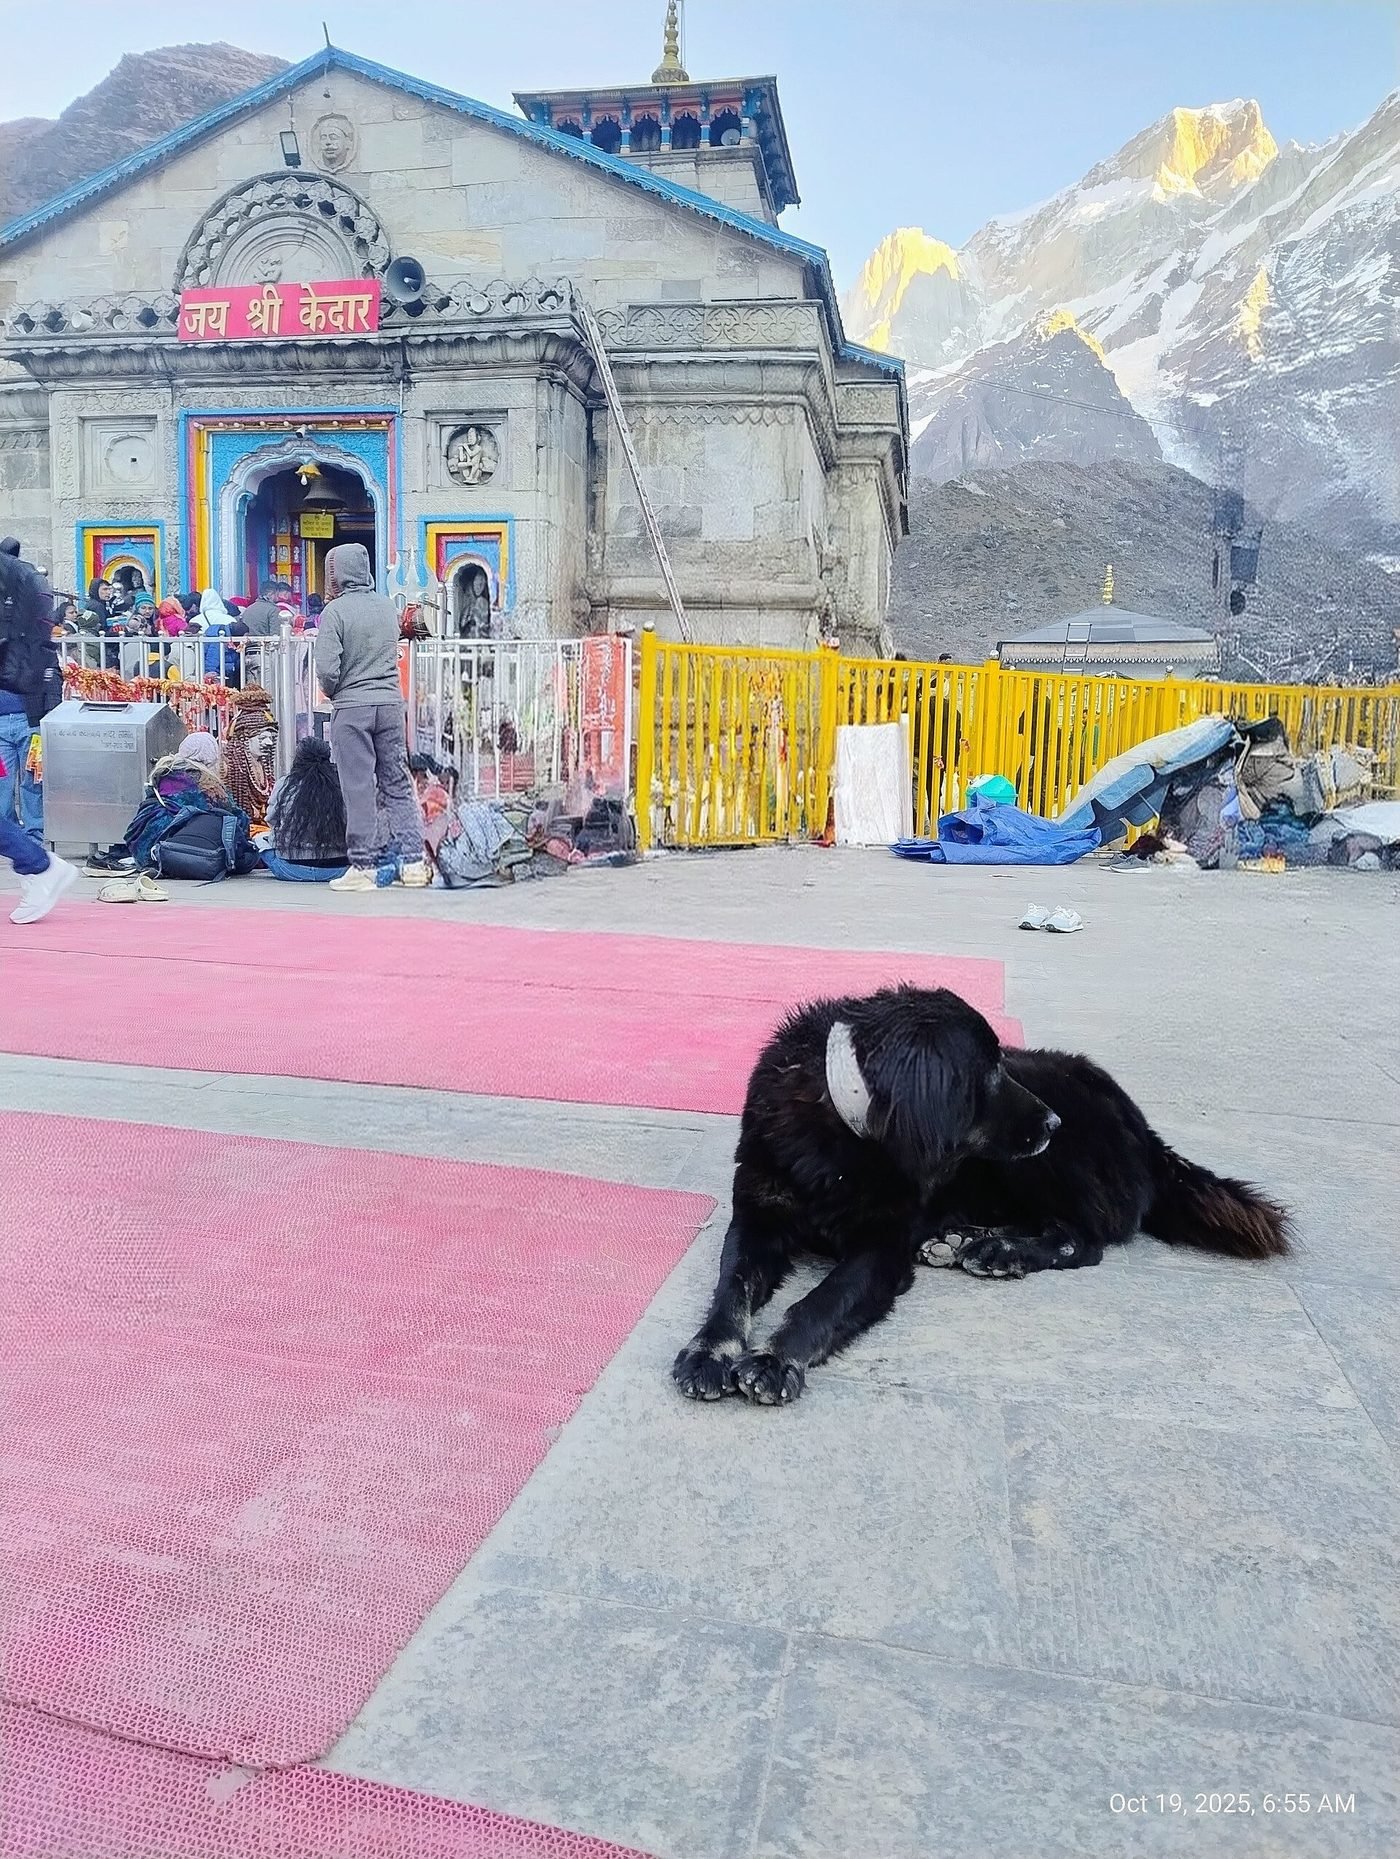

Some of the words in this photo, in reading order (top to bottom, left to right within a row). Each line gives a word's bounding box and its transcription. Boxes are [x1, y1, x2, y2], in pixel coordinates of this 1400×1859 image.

[184, 301, 231, 338] जय
[246, 284, 284, 335] श्री
[300, 282, 374, 333] केदार
